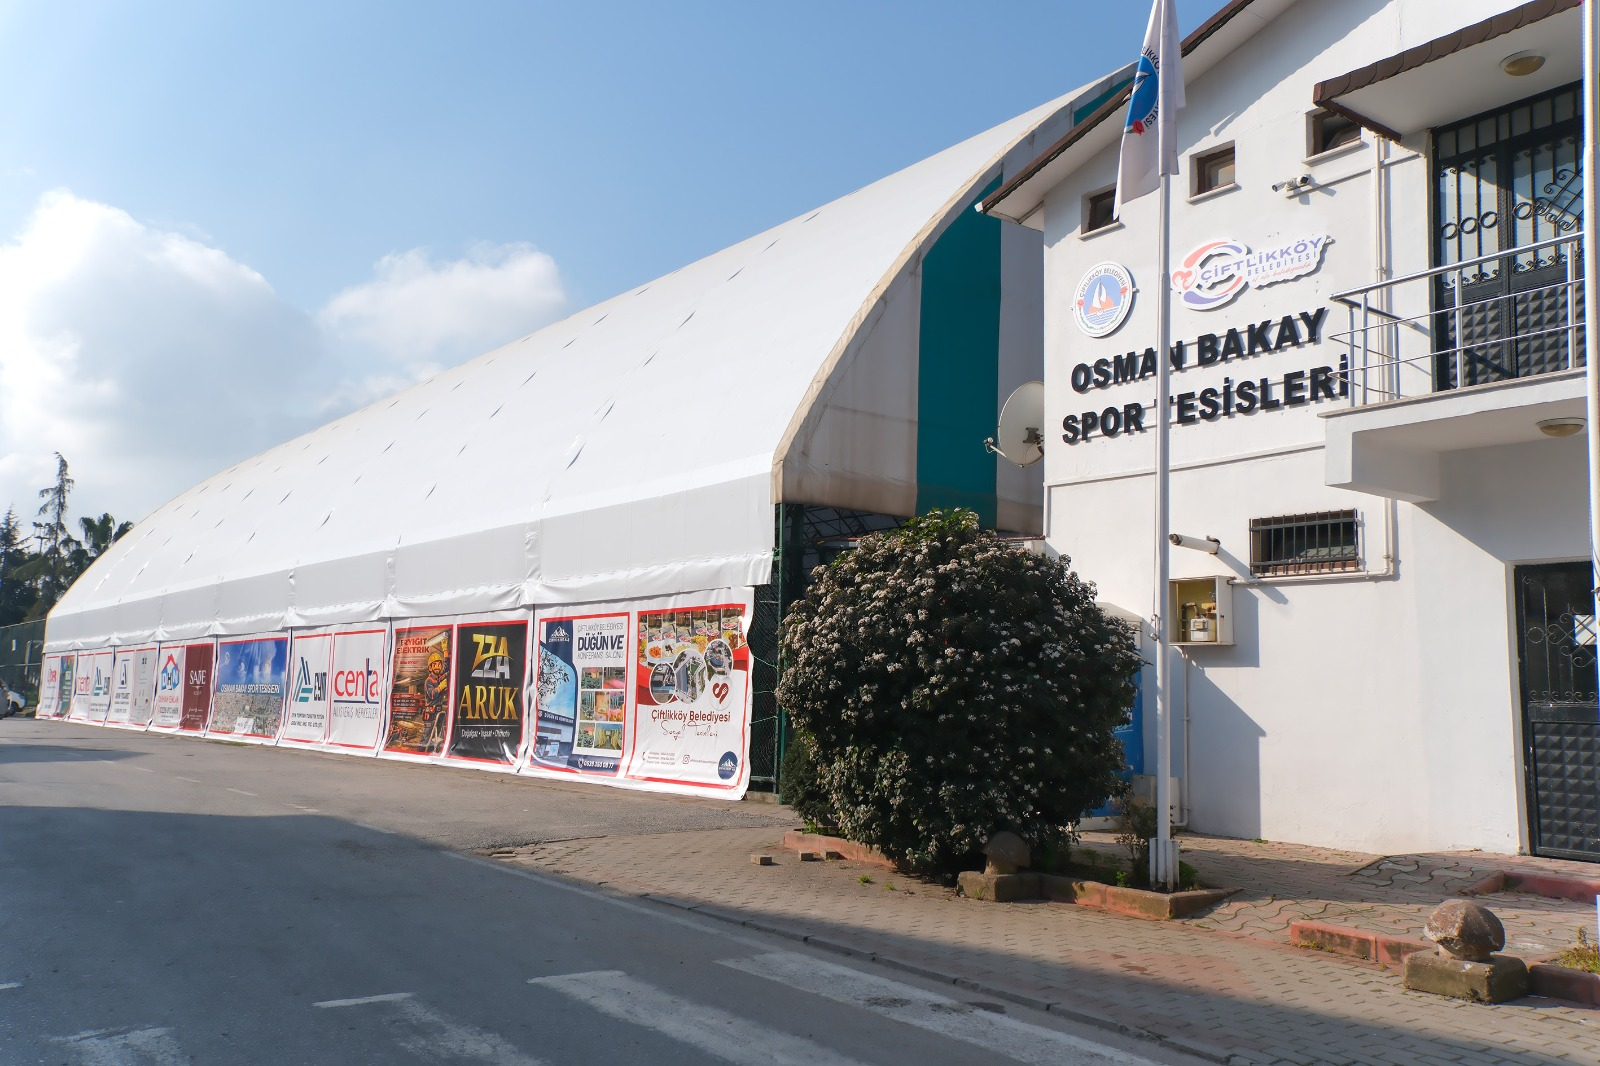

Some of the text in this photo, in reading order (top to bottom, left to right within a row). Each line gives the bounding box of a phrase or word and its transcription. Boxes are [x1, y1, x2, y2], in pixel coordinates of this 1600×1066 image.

[1200, 236, 1322, 283] ÇİFTLİKKÖY
[1247, 251, 1316, 277] BELEDİYESİ
[1071, 306, 1326, 393] OSMAN BAKAY
[1062, 353, 1348, 445] SPOR ESİSLERİ
[577, 631, 625, 651] DÜĞÜN VE
[334, 658, 379, 699] centa
[457, 684, 519, 721] ARUK
[651, 709, 731, 724] Çiftlikköy Belediyesi
